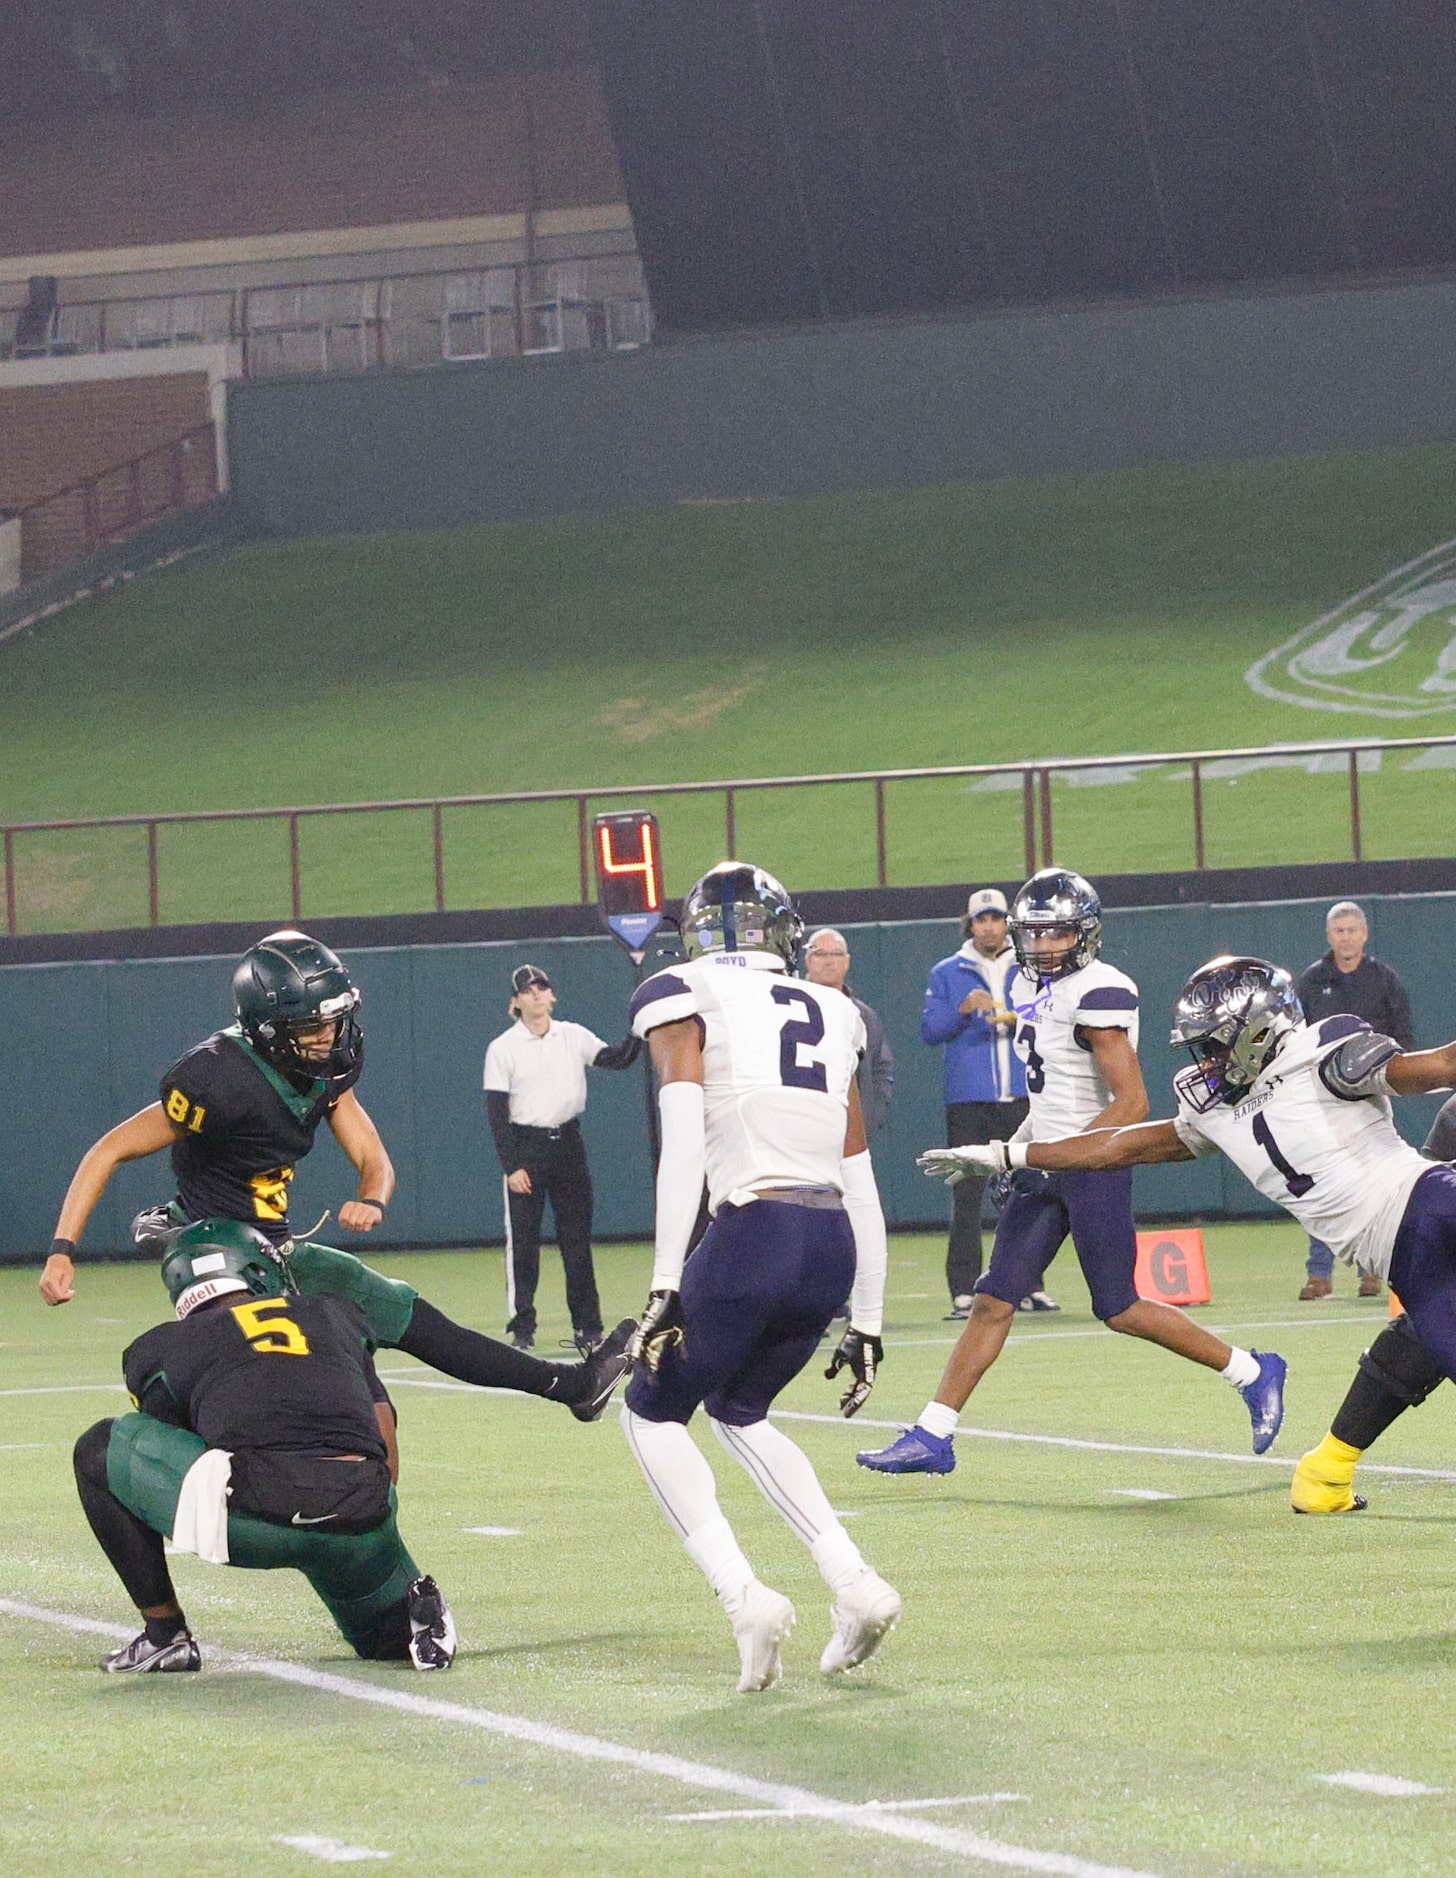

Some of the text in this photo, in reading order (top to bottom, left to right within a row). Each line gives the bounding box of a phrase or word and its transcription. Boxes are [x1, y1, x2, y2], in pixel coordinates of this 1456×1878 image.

[599, 823, 657, 909] 4
[770, 984, 828, 1093] 2
[1017, 1024, 1045, 1094] 3
[167, 1089, 206, 1133] 81
[1233, 1091, 1275, 1121] RAIDERS
[1252, 1110, 1316, 1198] 1
[1151, 1242, 1191, 1296] G
[176, 1283, 218, 1318] Riddell
[231, 1297, 310, 1355] 5
